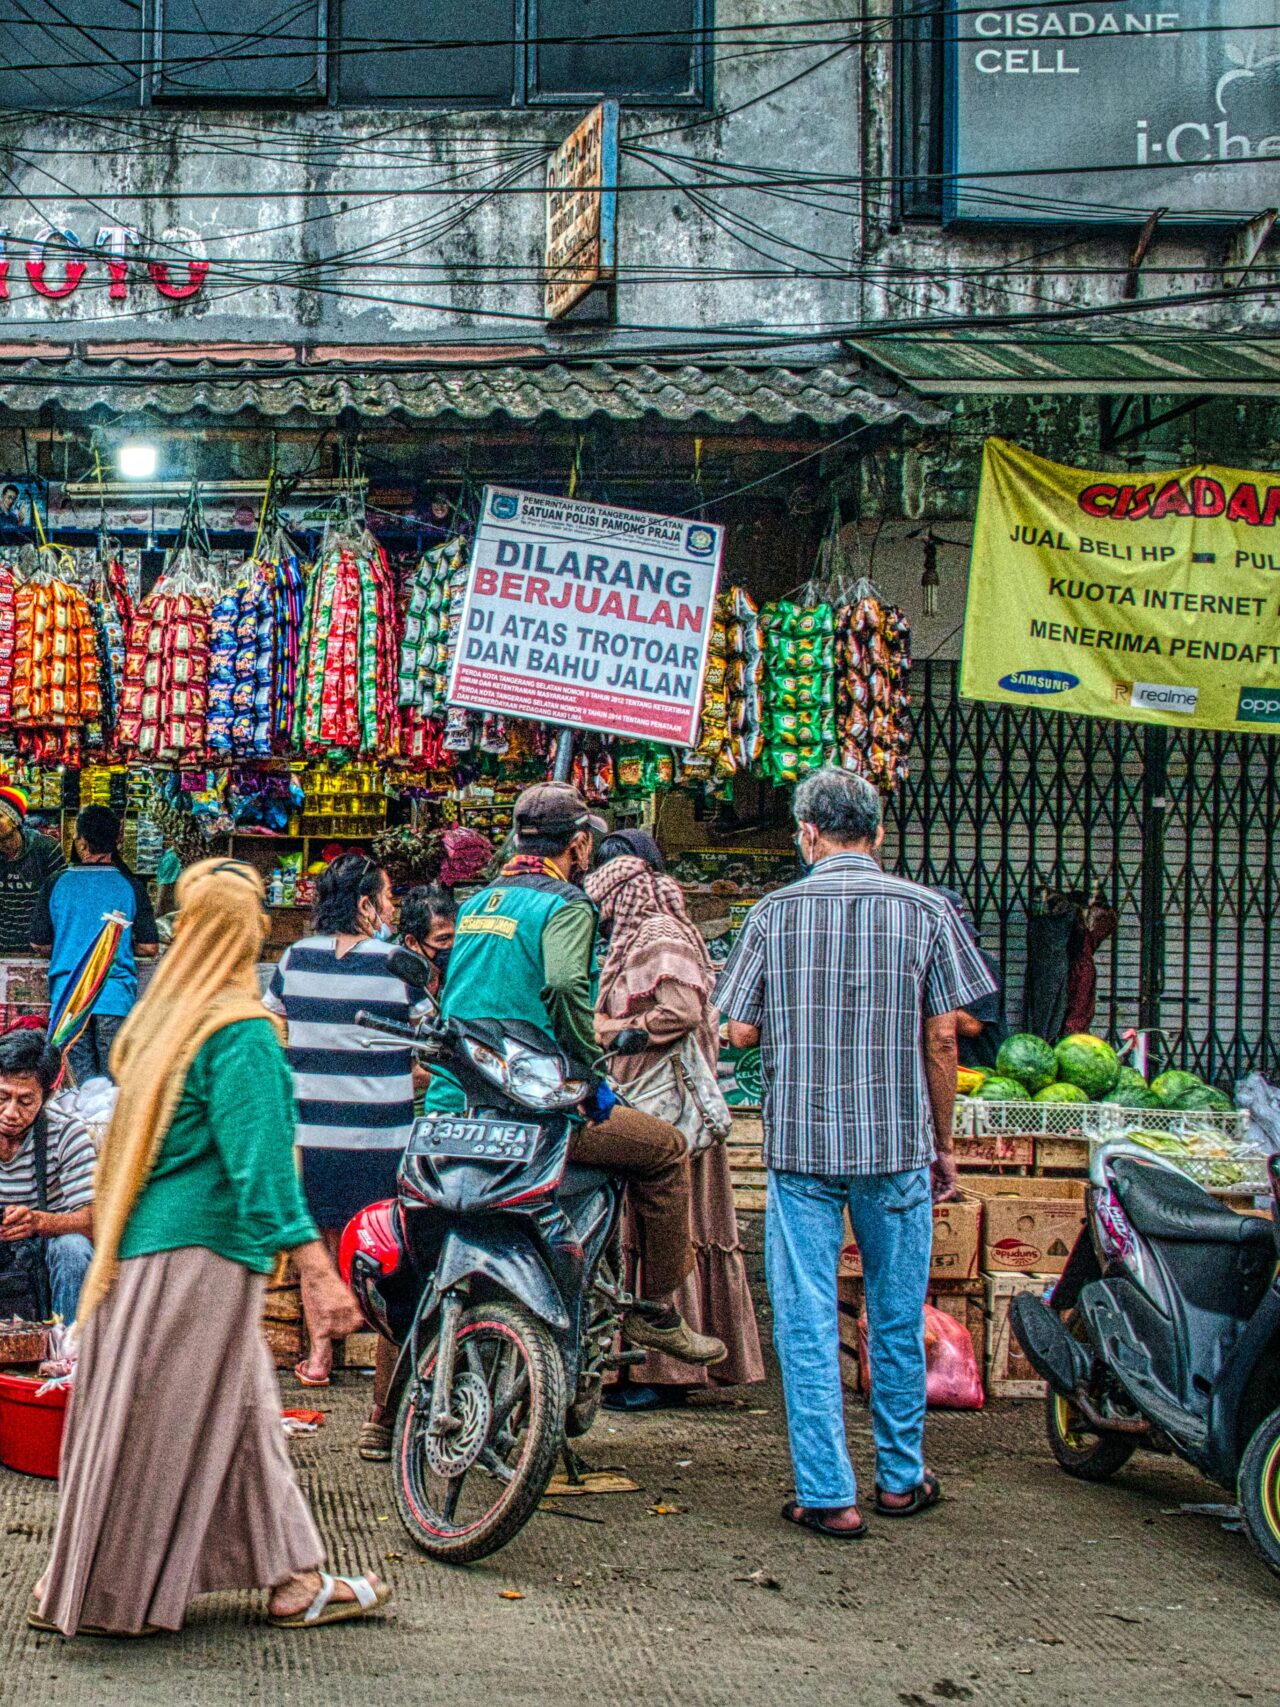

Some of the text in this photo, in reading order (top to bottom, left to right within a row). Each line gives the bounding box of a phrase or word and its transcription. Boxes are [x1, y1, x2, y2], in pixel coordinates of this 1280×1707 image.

[974, 12, 1181, 38] CISADANE
[974, 49, 1080, 74] CELL
[522, 505, 564, 521] SATUAN
[565, 512, 599, 527] POLISI
[601, 518, 645, 535] PAMONG
[647, 526, 681, 542] PRAJA
[523, 496, 683, 530] PEMERINTAH KOTA TANGERANG SELATAN
[1009, 525, 1071, 552] JUAL
[1079, 536, 1132, 561] BELI
[1142, 545, 1176, 562] HP
[495, 539, 692, 598] DILARANG
[474, 567, 705, 633] BERJUALAN
[1048, 577, 1267, 617] KUOTA INTERNET
[468, 608, 699, 670] DI ATAS TROTOAR
[1030, 619, 1162, 656] MENERIMA
[465, 637, 692, 699] DAN BAHU JALAN
[482, 671, 498, 680] KOTA
[499, 675, 535, 688] TANGERANG
[536, 681, 562, 692] SELATAN
[1010, 672, 1070, 691] SAMSUNG
[479, 689, 495, 697] KOTA
[496, 692, 532, 705] TANGERANG
[1140, 688, 1197, 707] realme
[418, 1122, 434, 1137] B
[440, 1122, 486, 1140] 3571
[995, 1248, 1038, 1260] Sunpride
